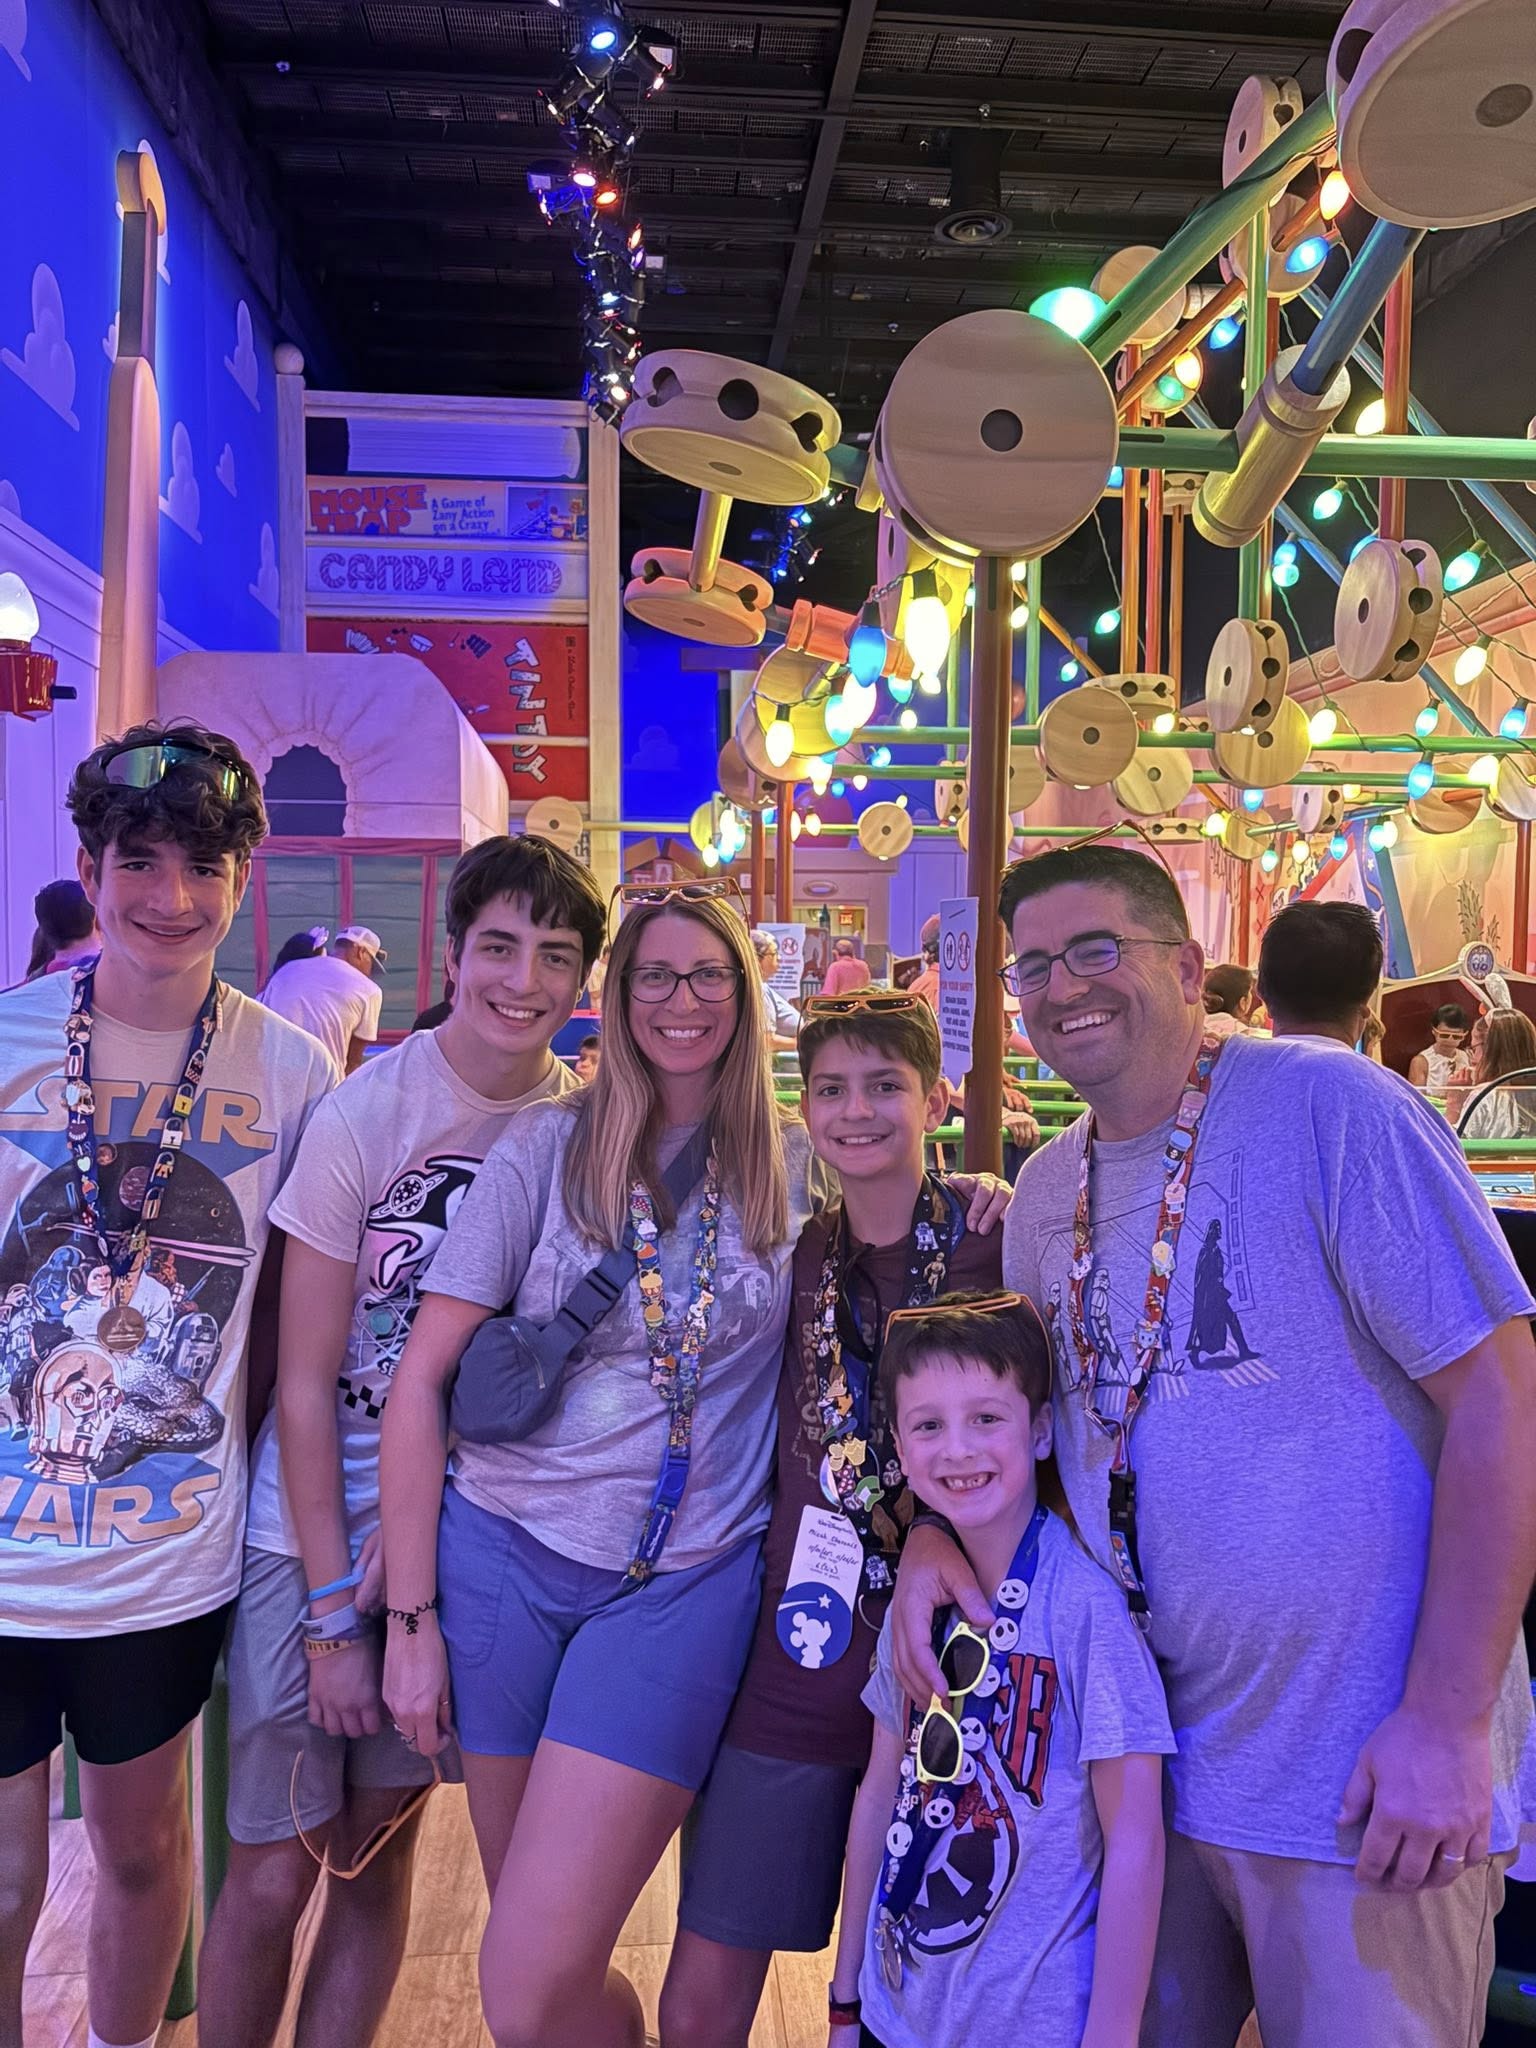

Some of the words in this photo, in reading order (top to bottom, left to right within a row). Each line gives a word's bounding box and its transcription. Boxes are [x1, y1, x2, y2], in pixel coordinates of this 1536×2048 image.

[308, 484, 429, 515] MOUSE
[431, 498, 439, 508] A
[441, 498, 473, 509] Game
[475, 495, 486, 507] of
[310, 509, 412, 535] TRAP
[432, 509, 458, 522] Zany
[462, 508, 495, 519] Action
[433, 523, 447, 532] on
[449, 523, 457, 531] a
[458, 520, 489, 532] Crazy
[319, 552, 454, 592] CANDY
[461, 556, 562, 594] LAND
[0, 1076, 277, 1152] STAR
[0, 1473, 221, 1548] ARS
